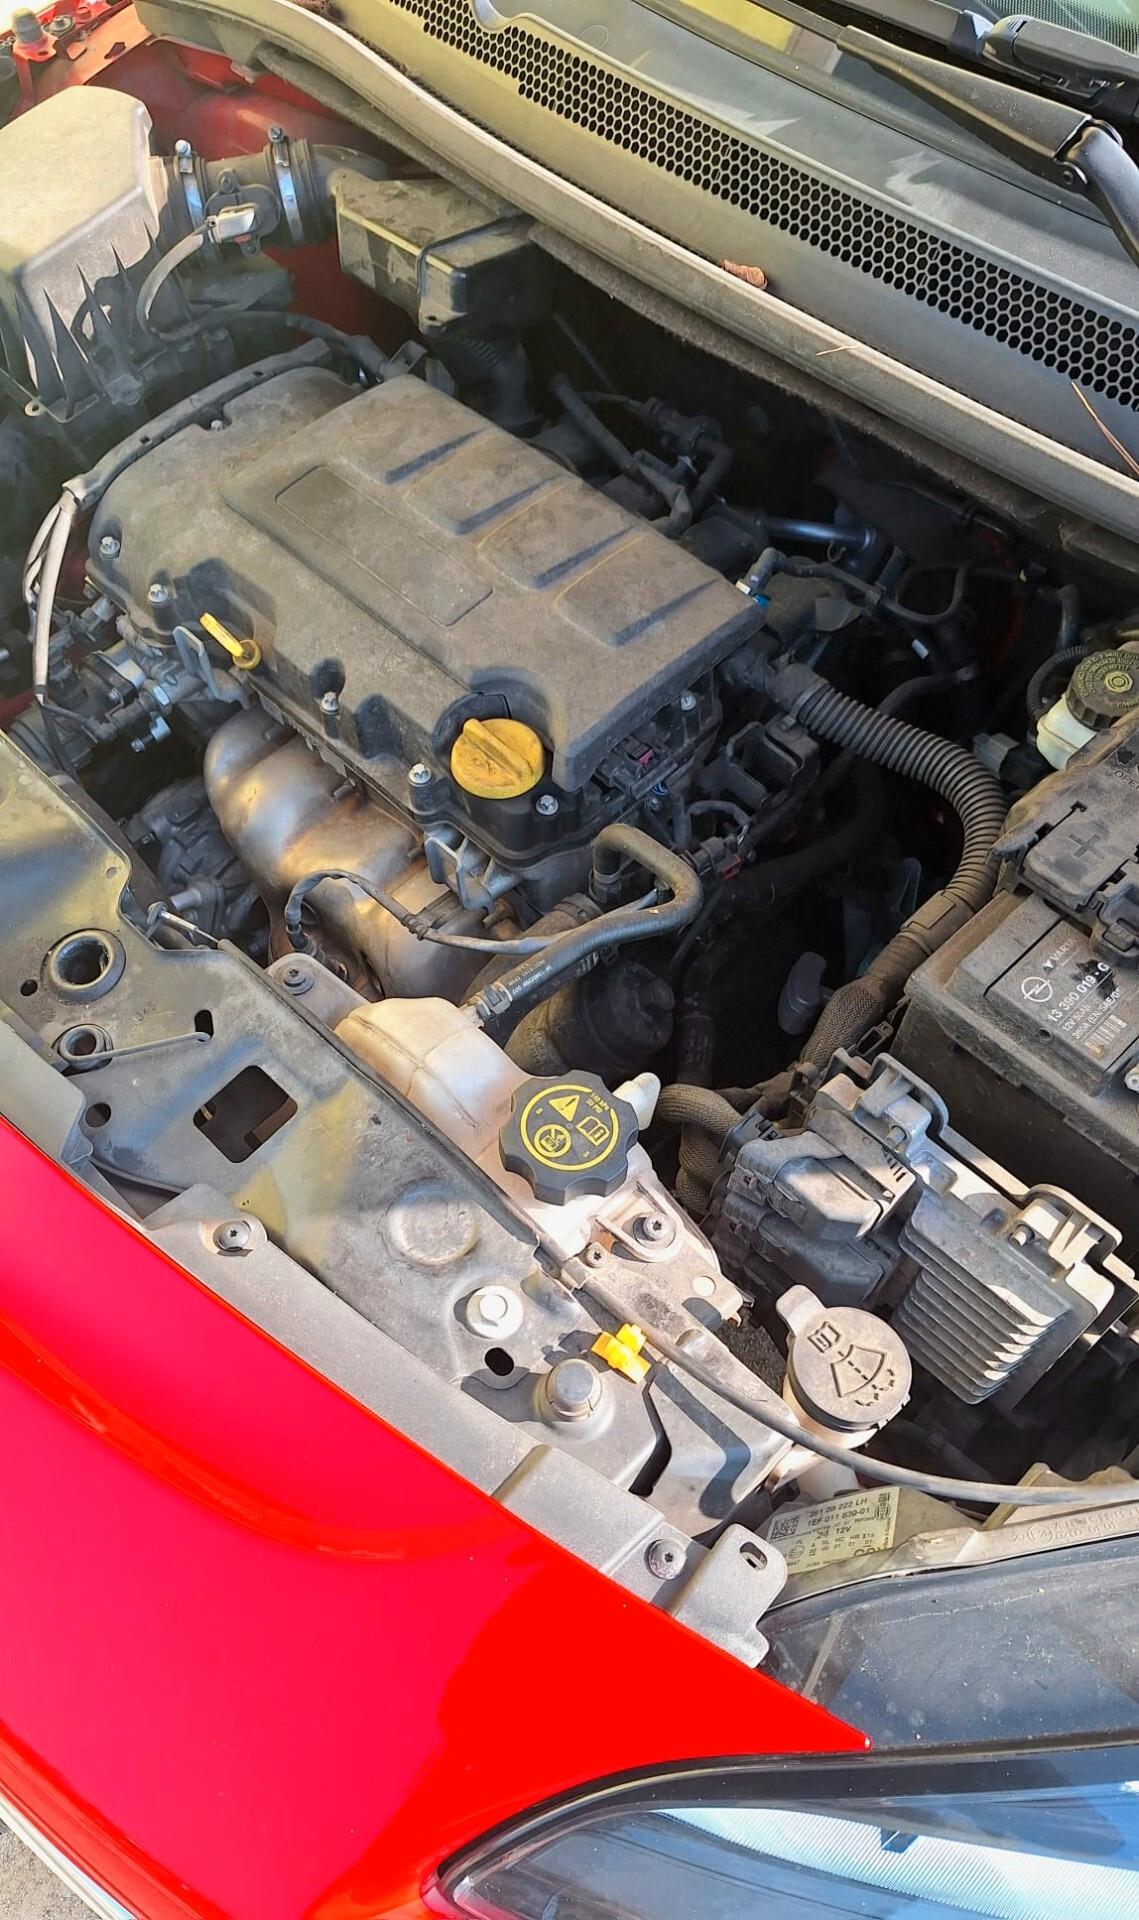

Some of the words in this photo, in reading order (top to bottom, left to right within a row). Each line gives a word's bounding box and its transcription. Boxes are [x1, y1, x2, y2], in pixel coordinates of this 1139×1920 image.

[1050, 938, 1078, 961] VARTA
[1048, 1009, 1063, 1021] 13
[1058, 991, 1080, 1011] 390
[1076, 975, 1097, 993] 019
[1097, 962, 1109, 972] G
[1062, 1020, 1076, 1032] 12V
[855, 1497, 868, 1506] LH
[836, 1526, 852, 1534] 12V
